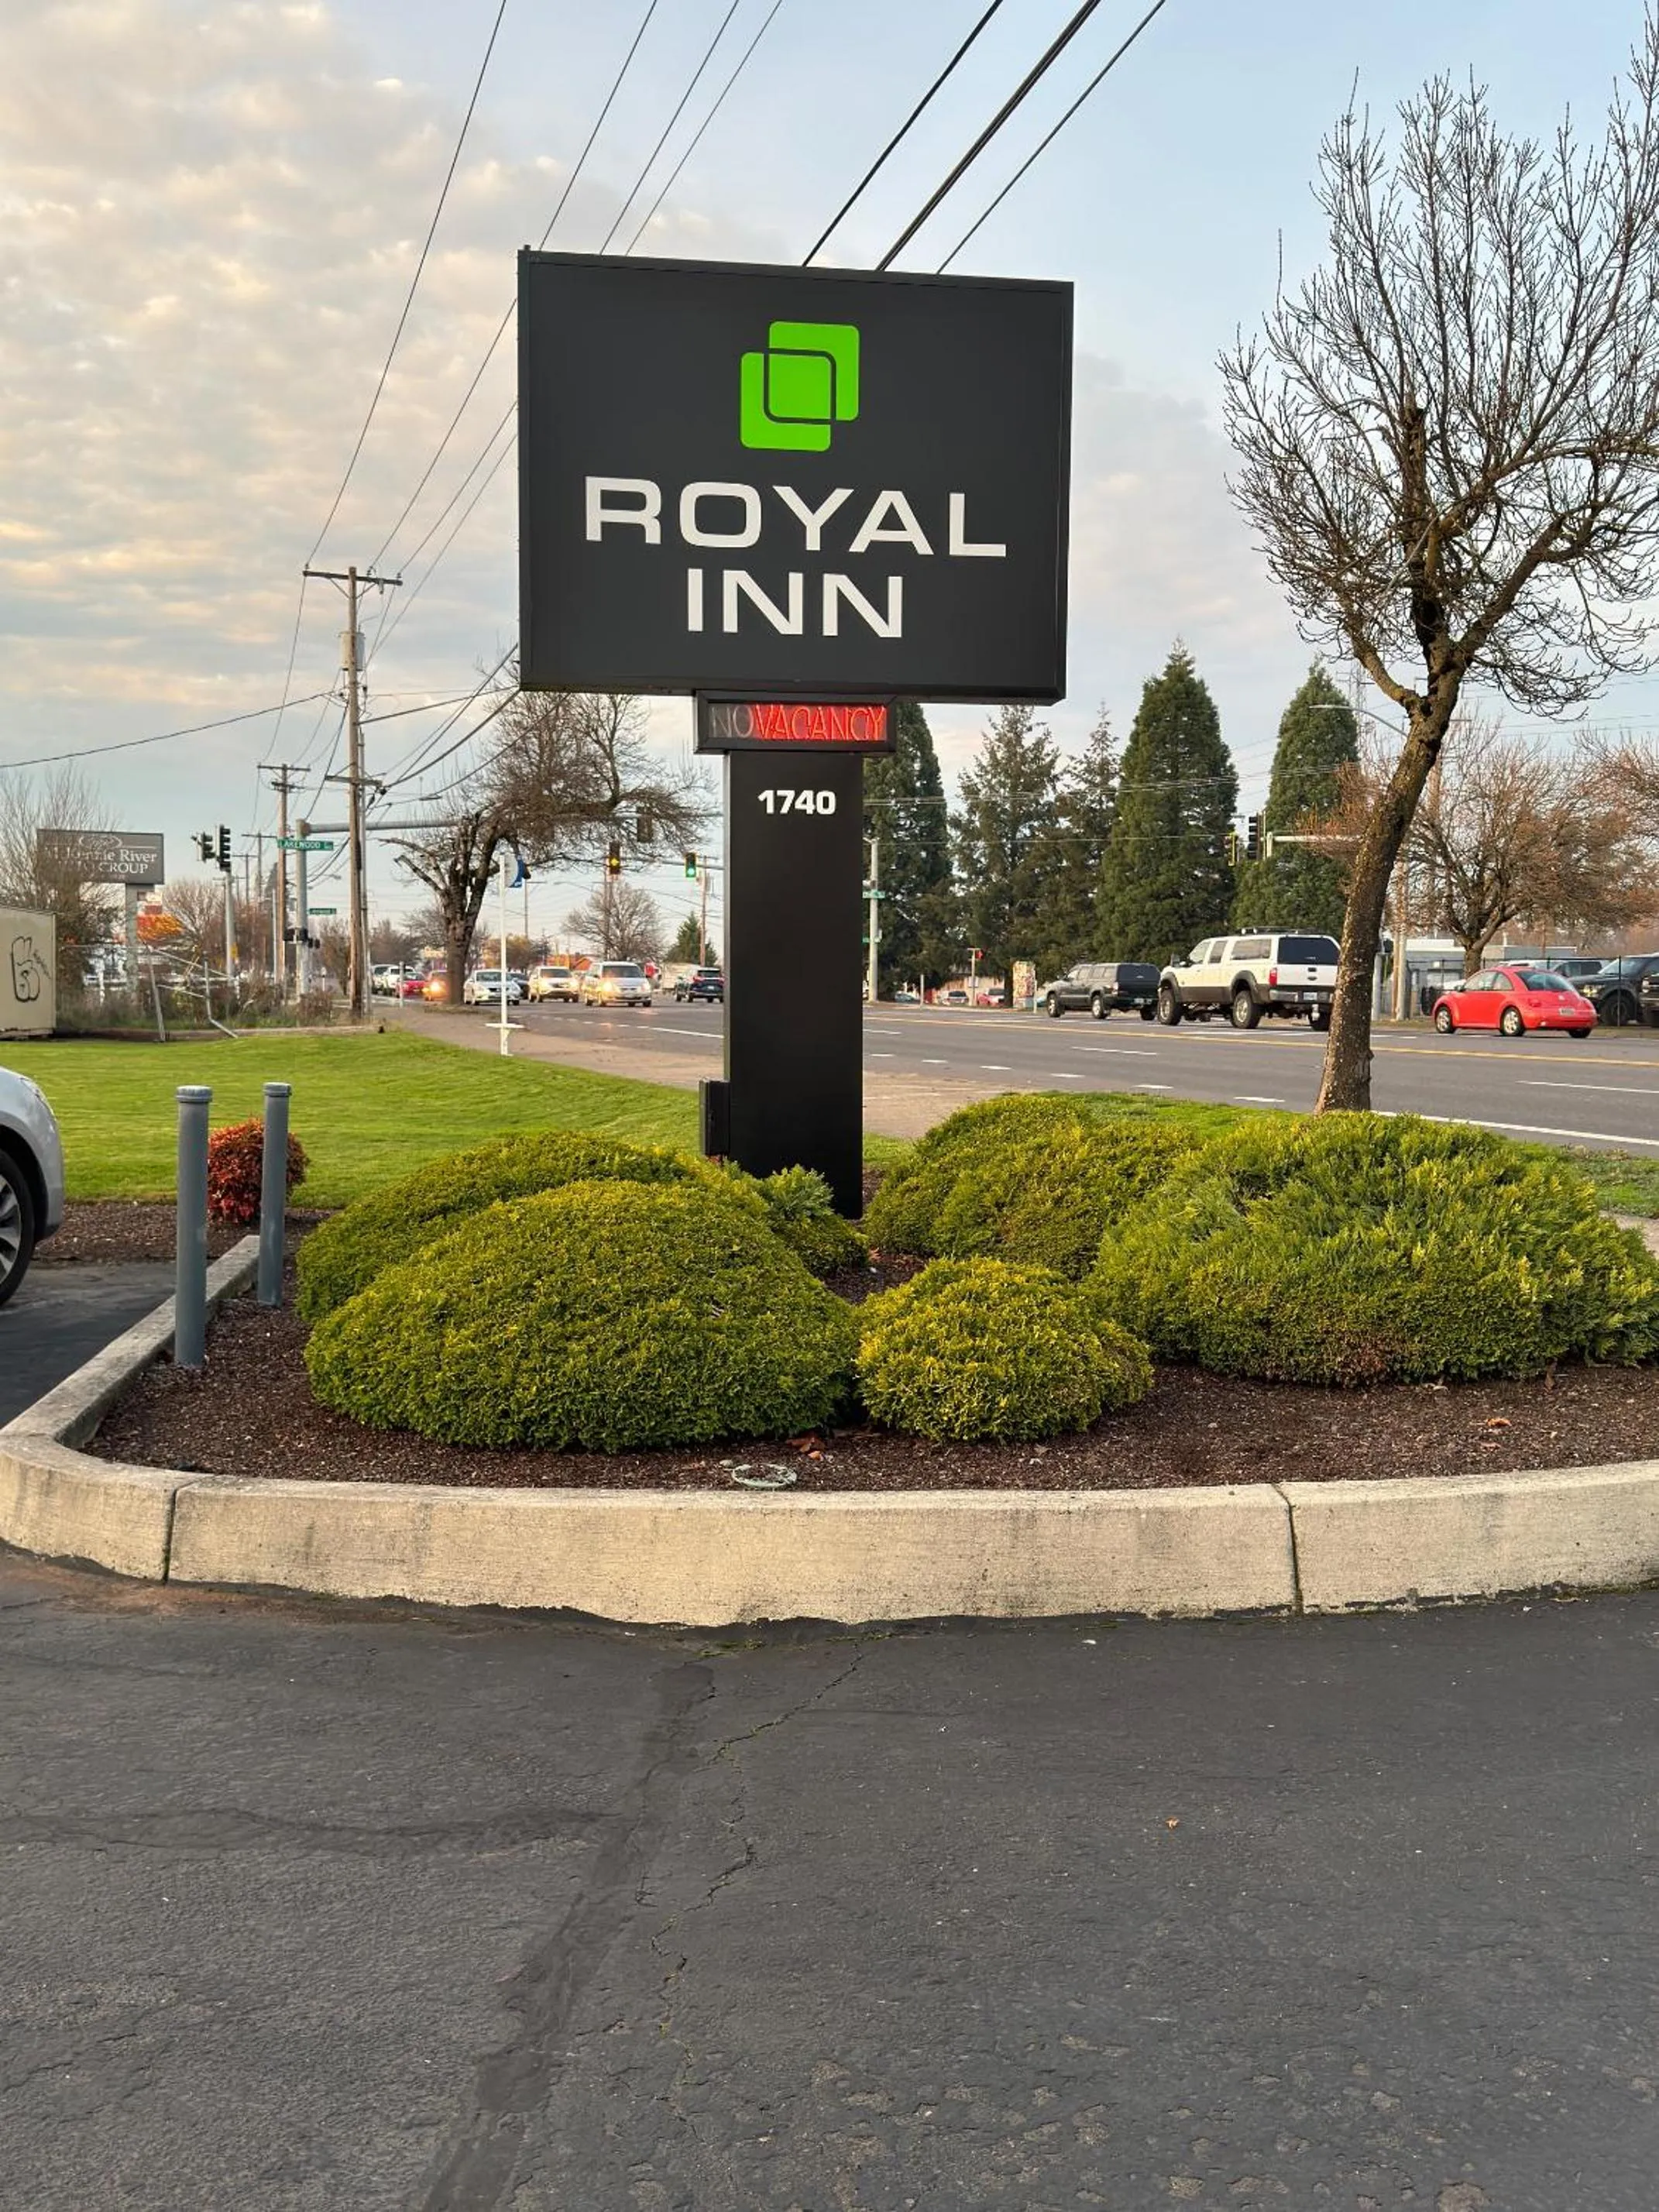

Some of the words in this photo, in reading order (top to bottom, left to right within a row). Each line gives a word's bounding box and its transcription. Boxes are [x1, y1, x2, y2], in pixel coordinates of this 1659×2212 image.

[585, 476, 1007, 558] ROYAL
[687, 568, 903, 638] INN
[755, 703, 885, 741] VACANCY
[757, 789, 836, 815] 1740
[119, 849, 157, 863] River
